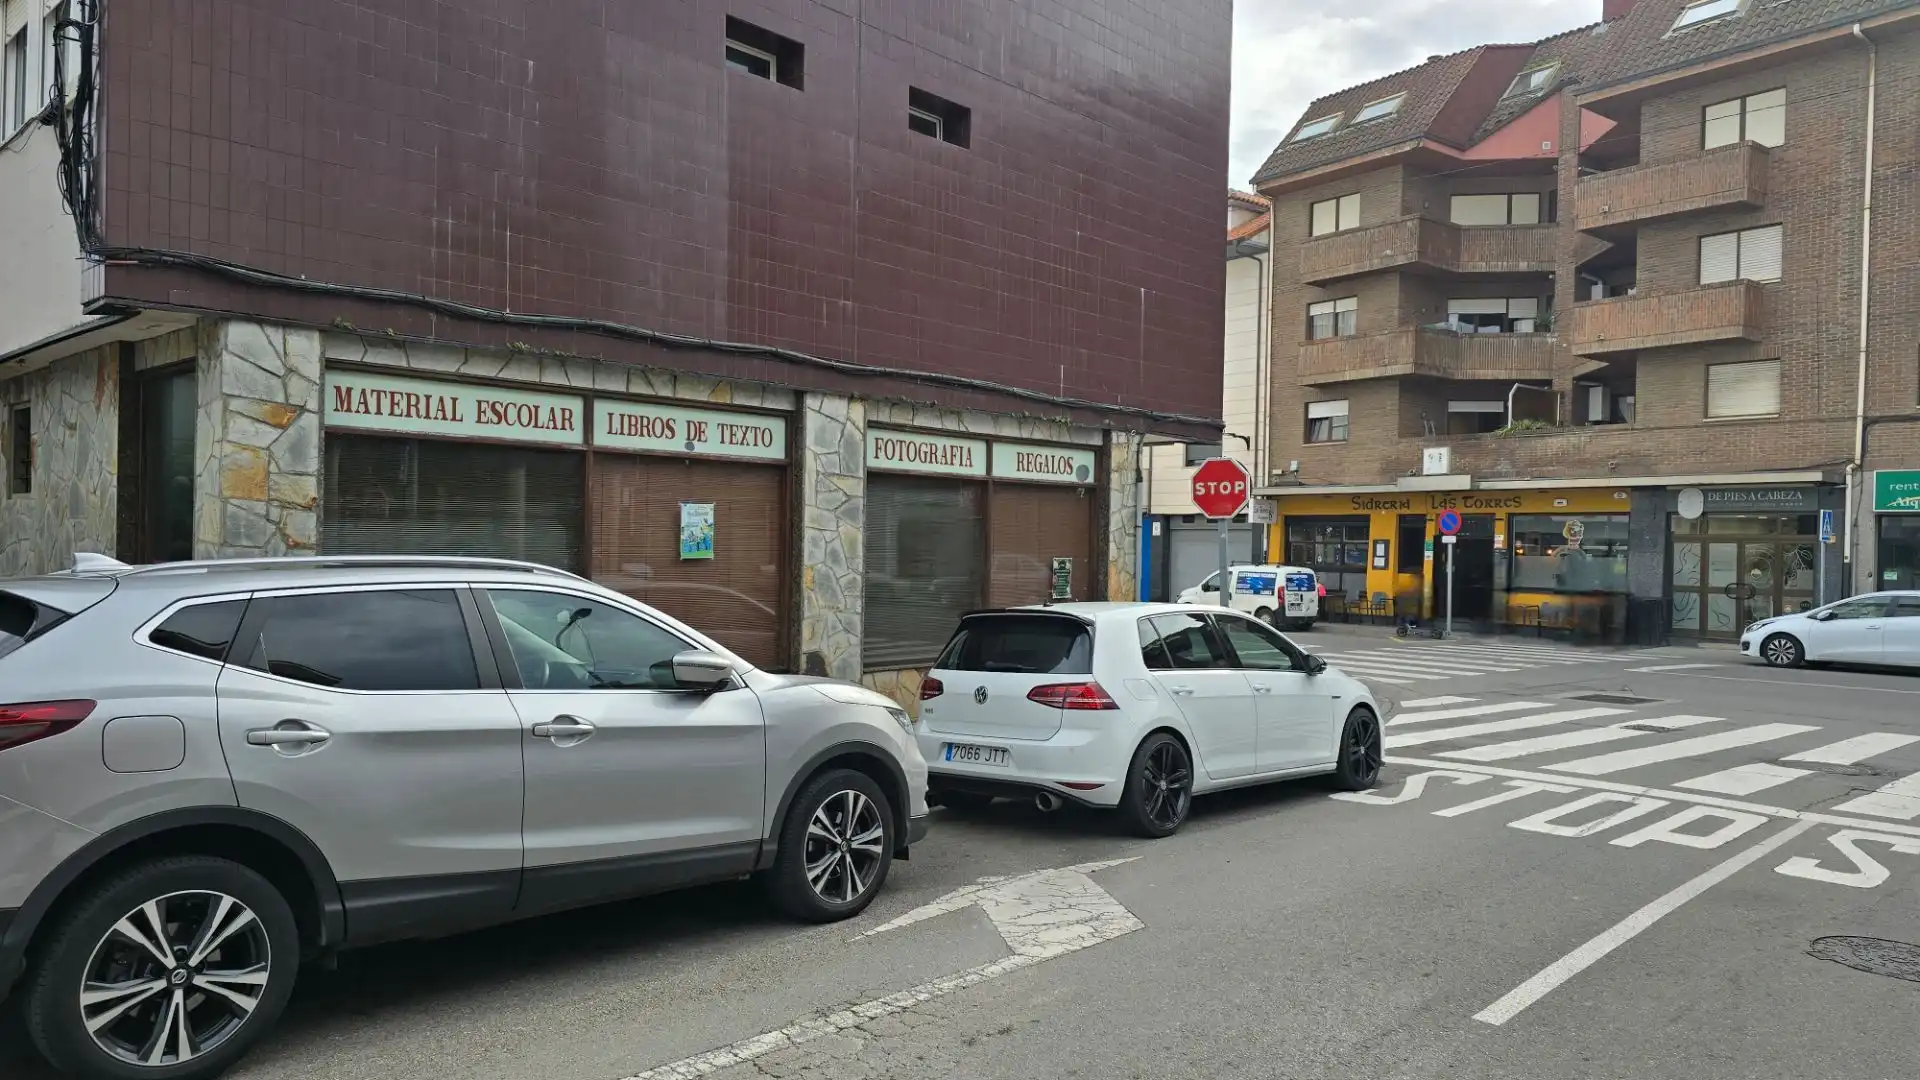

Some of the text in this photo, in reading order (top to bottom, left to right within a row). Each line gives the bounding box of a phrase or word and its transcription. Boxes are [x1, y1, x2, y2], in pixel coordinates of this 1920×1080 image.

[333, 385, 575, 431] MATERIAL ESCOLAR
[607, 412, 773, 448] LIBROS DE TEXTO
[873, 437, 1074, 475] FOTOGRAFIA REGALOS
[1195, 480, 1245, 496] STOP
[1708, 491, 1722, 500] DE
[1748, 491, 1756, 501] A
[1757, 490, 1803, 500] CABEZA
[1889, 482, 1920, 491] rent
[952, 745, 1009, 764] 7066 JTT
[1328, 770, 1769, 849] STOP
